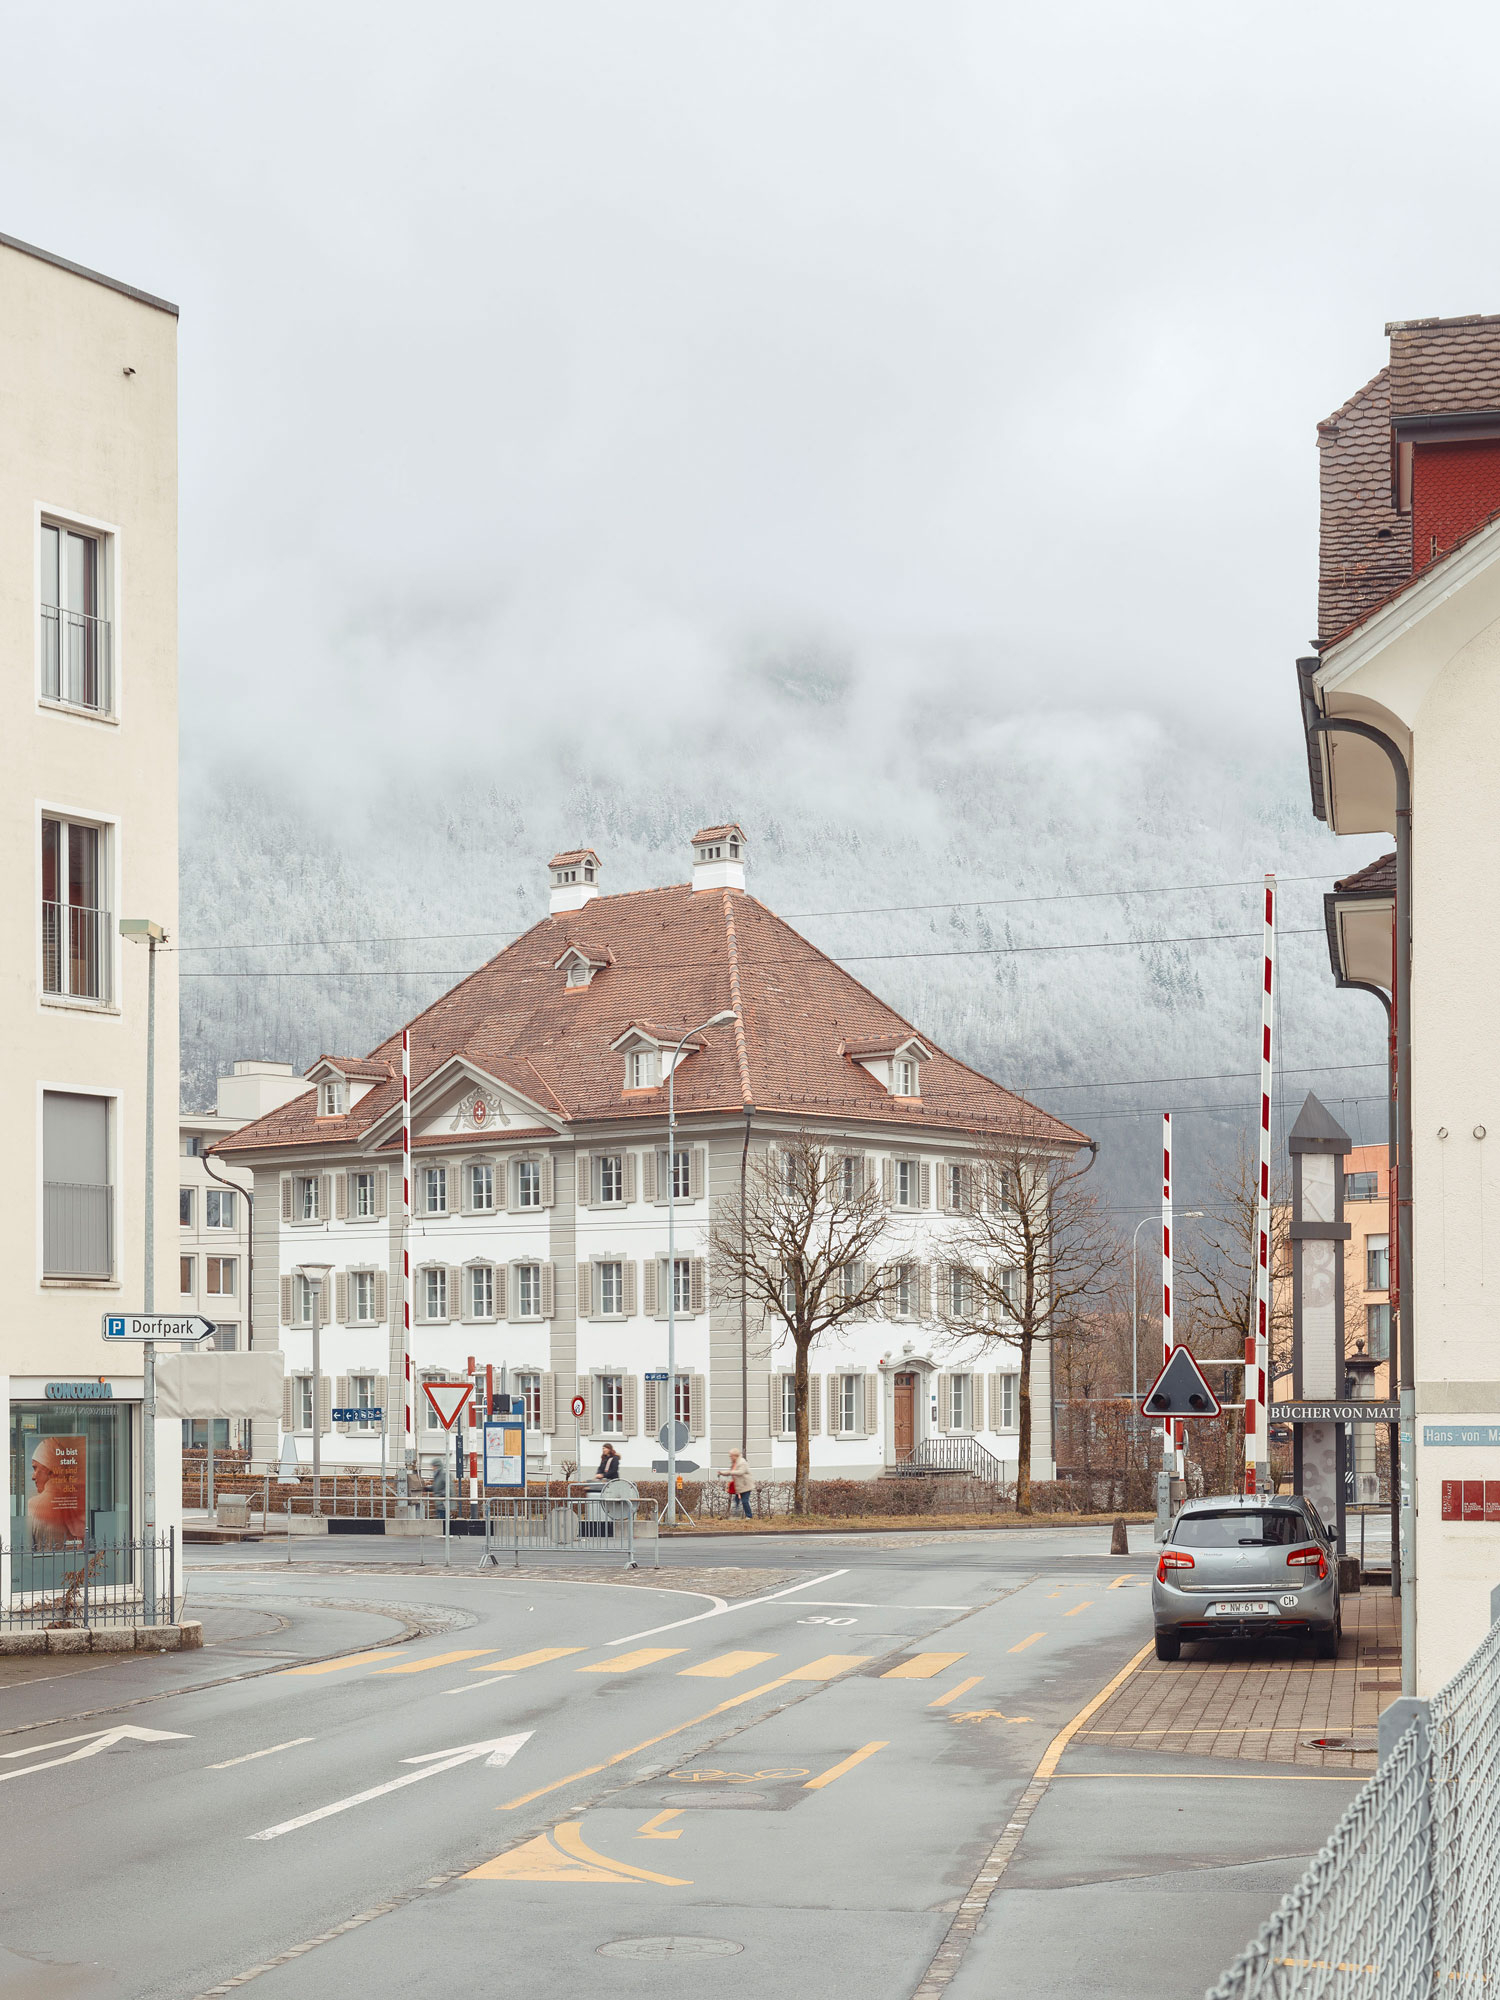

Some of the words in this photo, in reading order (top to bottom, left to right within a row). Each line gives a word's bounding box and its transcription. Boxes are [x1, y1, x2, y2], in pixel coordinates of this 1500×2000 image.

[132, 1320, 193, 1337] Dorfpark
[45, 1377, 113, 1399] CONCORDIA
[1271, 1405, 1331, 1419] BÜCHER
[1332, 1407, 1365, 1419] VON
[55, 1448, 64, 1456] Du
[66, 1448, 78, 1456] bist
[60, 1457, 78, 1465] stark.
[65, 1466, 78, 1474] sind
[1283, 1596, 1294, 1606] CH
[796, 1616, 858, 1626] 30
